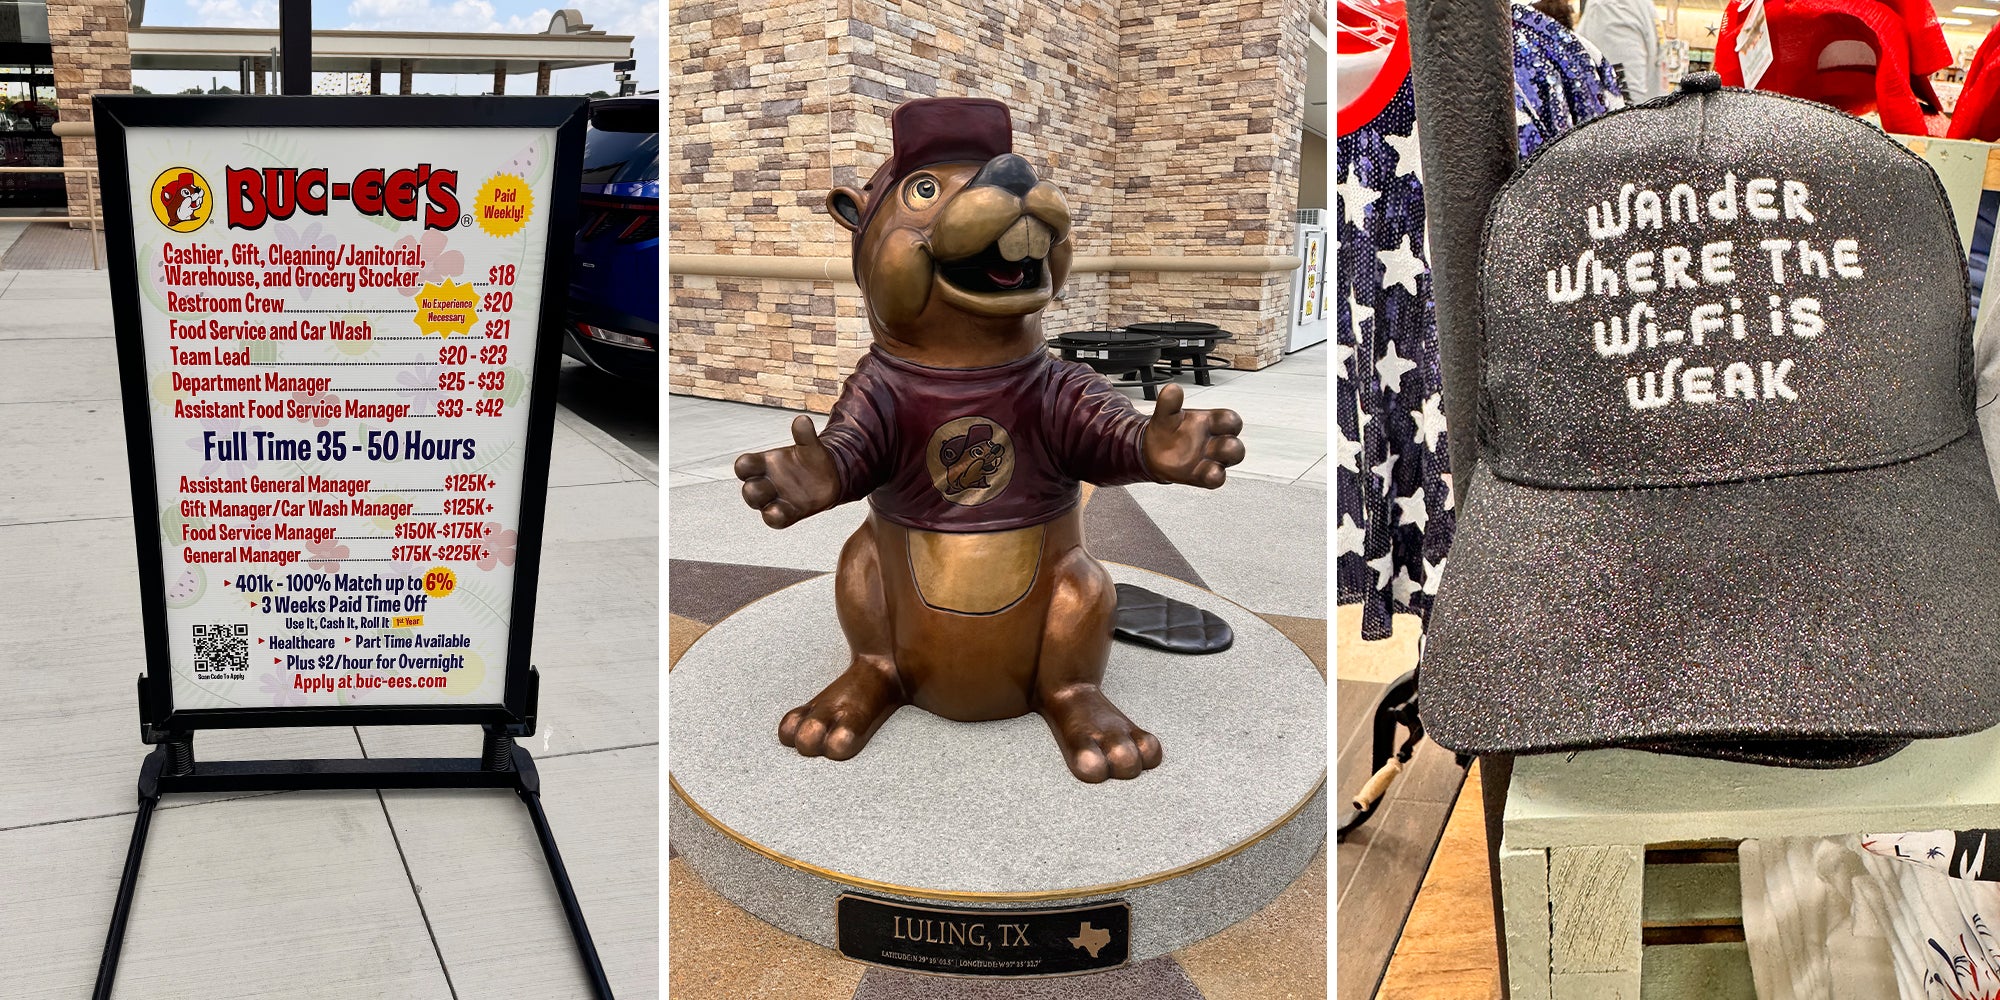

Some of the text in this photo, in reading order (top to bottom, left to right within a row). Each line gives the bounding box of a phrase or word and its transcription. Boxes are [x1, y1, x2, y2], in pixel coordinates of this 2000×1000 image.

[495, 189, 516, 202] Paid
[484, 205, 524, 222] Weekly!
[164, 242, 425, 271] Cashier, Gift, Cleaning/Janitorial,
[165, 264, 515, 292] Warehouse, and Grocery Stocker $18
[168, 291, 512, 313] Restroom Crew $20
[422, 299, 472, 310] No Experience
[428, 312, 465, 324] Necessary
[170, 319, 510, 340] Food Service and Car Wash $21
[170, 346, 212, 366] Team
[214, 346, 250, 366] Lead
[439, 345, 467, 365] $20
[480, 345, 508, 365] $23
[172, 372, 261, 396] Department
[265, 372, 331, 396] Manager
[438, 372, 465, 391] $25
[478, 371, 505, 391] $33
[1626, 358, 1798, 410] WEAK
[175, 400, 245, 418] Assistant
[249, 400, 284, 418] Food
[287, 400, 341, 418] Service
[345, 400, 410, 422] Manager
[437, 399, 464, 418] $33
[476, 399, 504, 418] $42
[203, 431, 247, 461] Full
[253, 431, 311, 461] Time
[317, 431, 346, 461] 35
[368, 430, 398, 460] 50
[404, 430, 475, 460] Hours
[180, 474, 496, 497] Assistant General Manager $125K+
[181, 498, 494, 520] Gift Manager/Car Wash Manager $125K+
[182, 522, 492, 544] Food Service Manager $150K-$175K+
[183, 545, 490, 566] General Manager $175K-$225K+
[236, 574, 273, 592] 401k
[287, 574, 331, 591] 100%
[335, 574, 380, 591] Match
[386, 578, 404, 595] up
[408, 576, 422, 591] to
[426, 572, 454, 591] 6%
[262, 594, 427, 613] 3 Weeks Paid Time Off
[286, 617, 389, 630] Use It, Cash It, Roll It
[405, 617, 420, 626] Year
[269, 634, 470, 649] Healthcare Part Time Available
[287, 654, 464, 672] Plus $2/hour for Overnight
[294, 674, 447, 693] Apply at buc-ees.com
[894, 916, 1030, 950] LULING, TX
